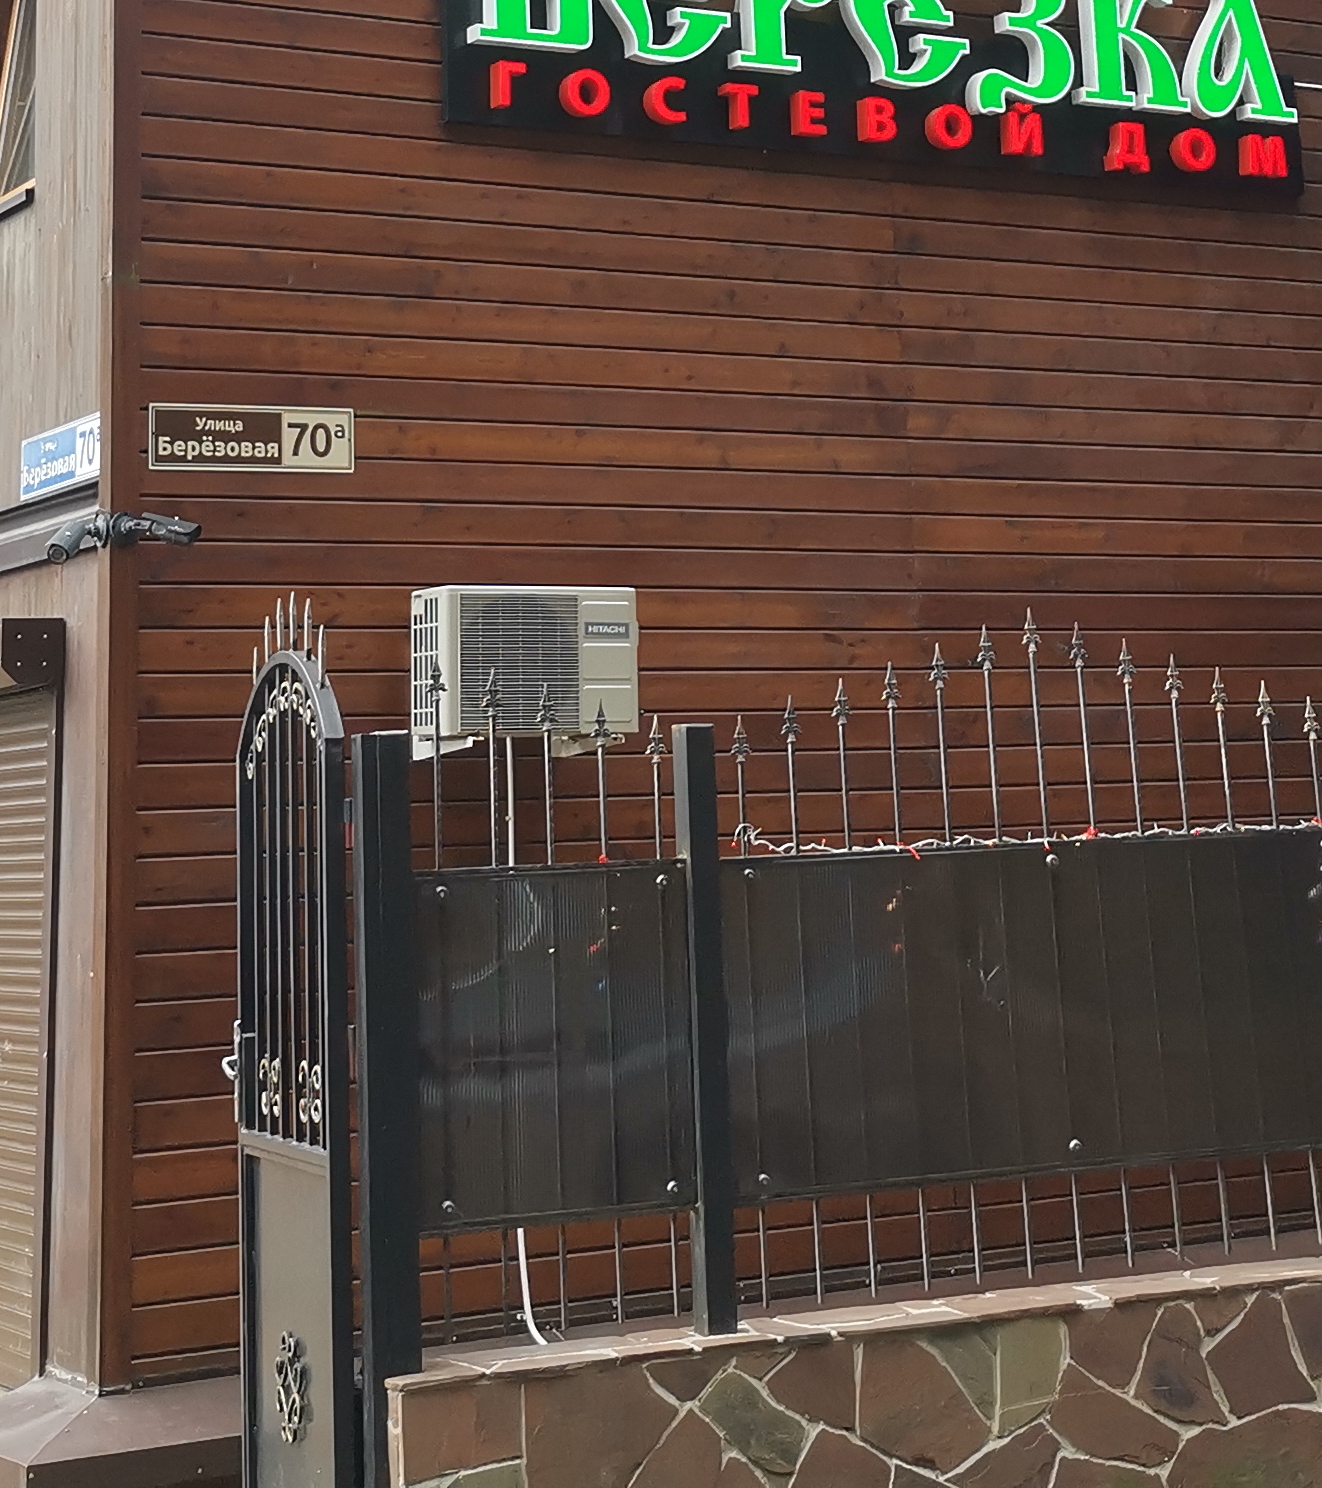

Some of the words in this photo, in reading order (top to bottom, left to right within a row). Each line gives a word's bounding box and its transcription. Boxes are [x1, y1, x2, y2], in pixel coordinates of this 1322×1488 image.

[488, 60, 1044, 157] ГОСТЕВОЙ
[1103, 121, 1290, 178] ДОМ
[195, 417, 244, 434] Улица
[157, 435, 279, 461] Берёзовая
[22, 453, 75, 488] Берёзовая
[587, 624, 626, 634] HITACHI
